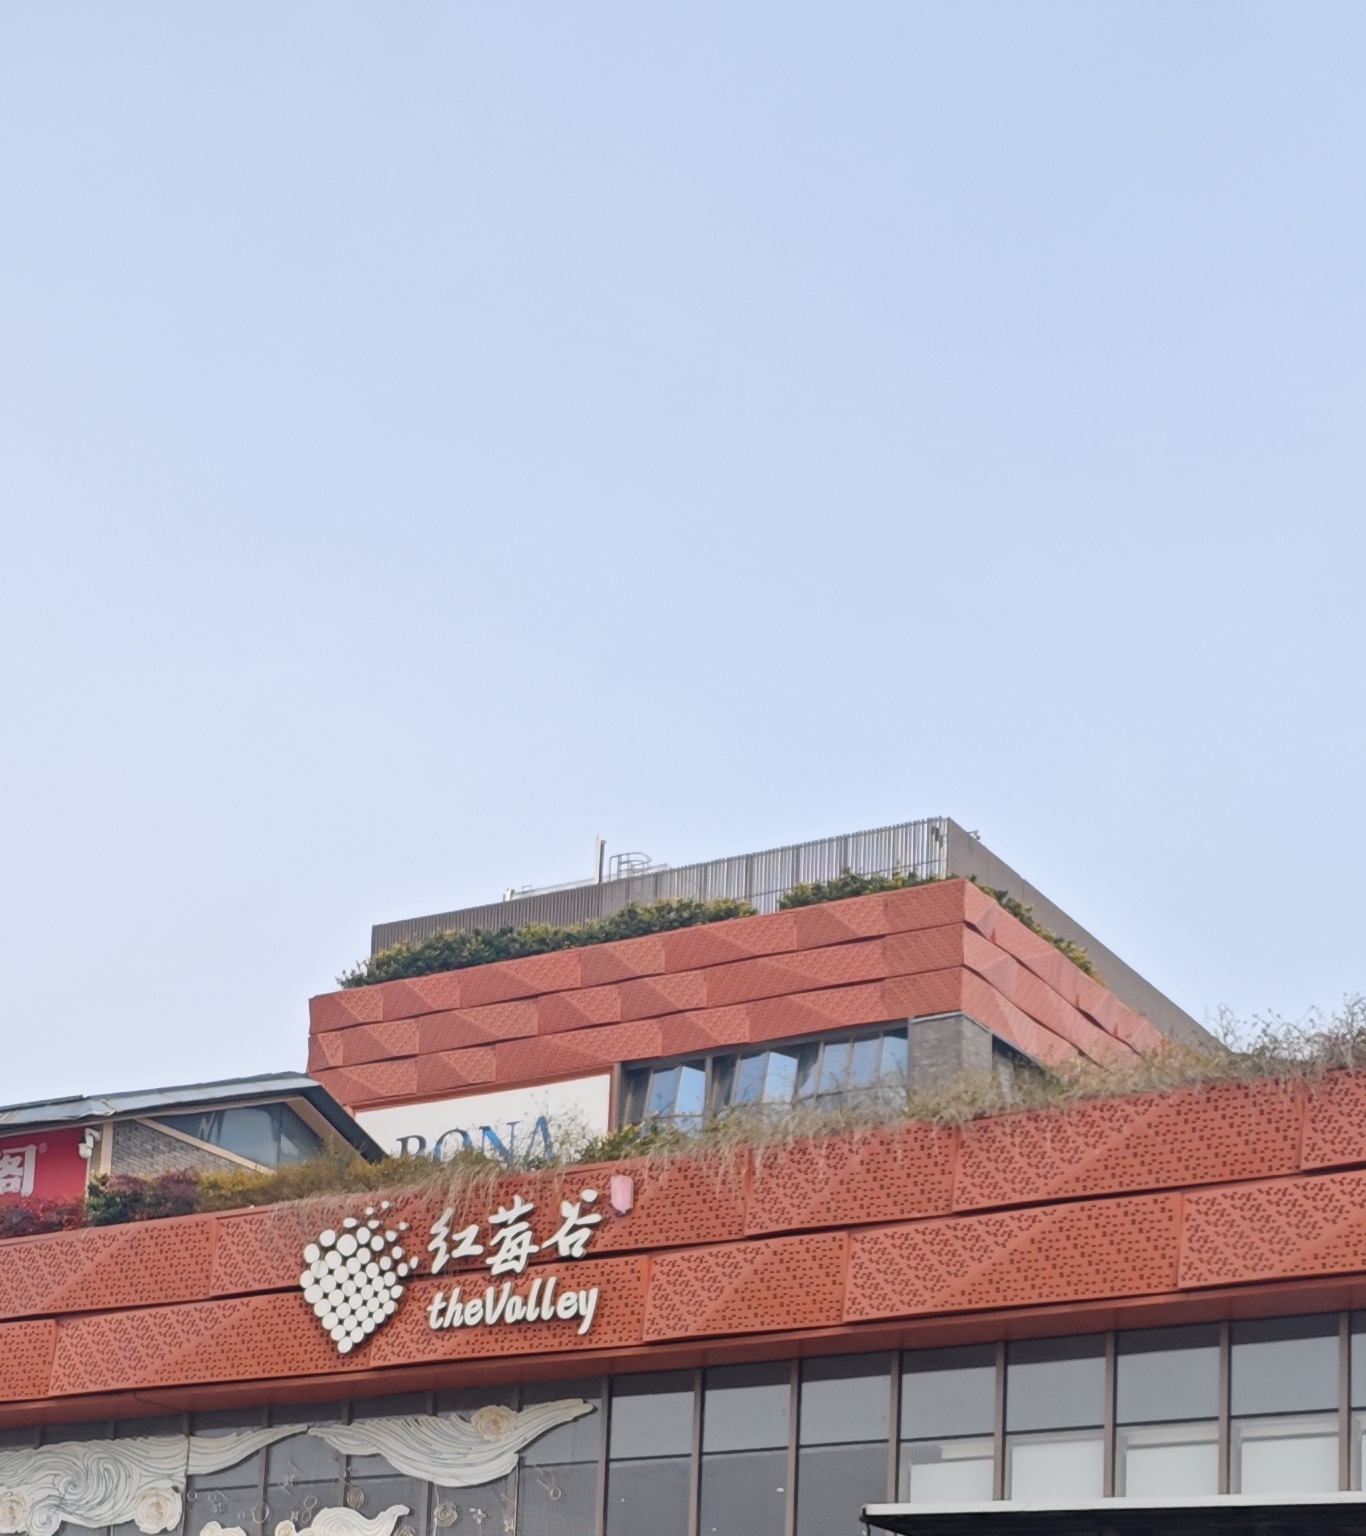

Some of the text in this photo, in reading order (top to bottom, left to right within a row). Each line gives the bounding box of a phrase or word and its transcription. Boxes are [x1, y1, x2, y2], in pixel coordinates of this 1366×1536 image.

[428, 1189, 602, 1276] 红莓谷
[427, 1276, 599, 1335] theValley
